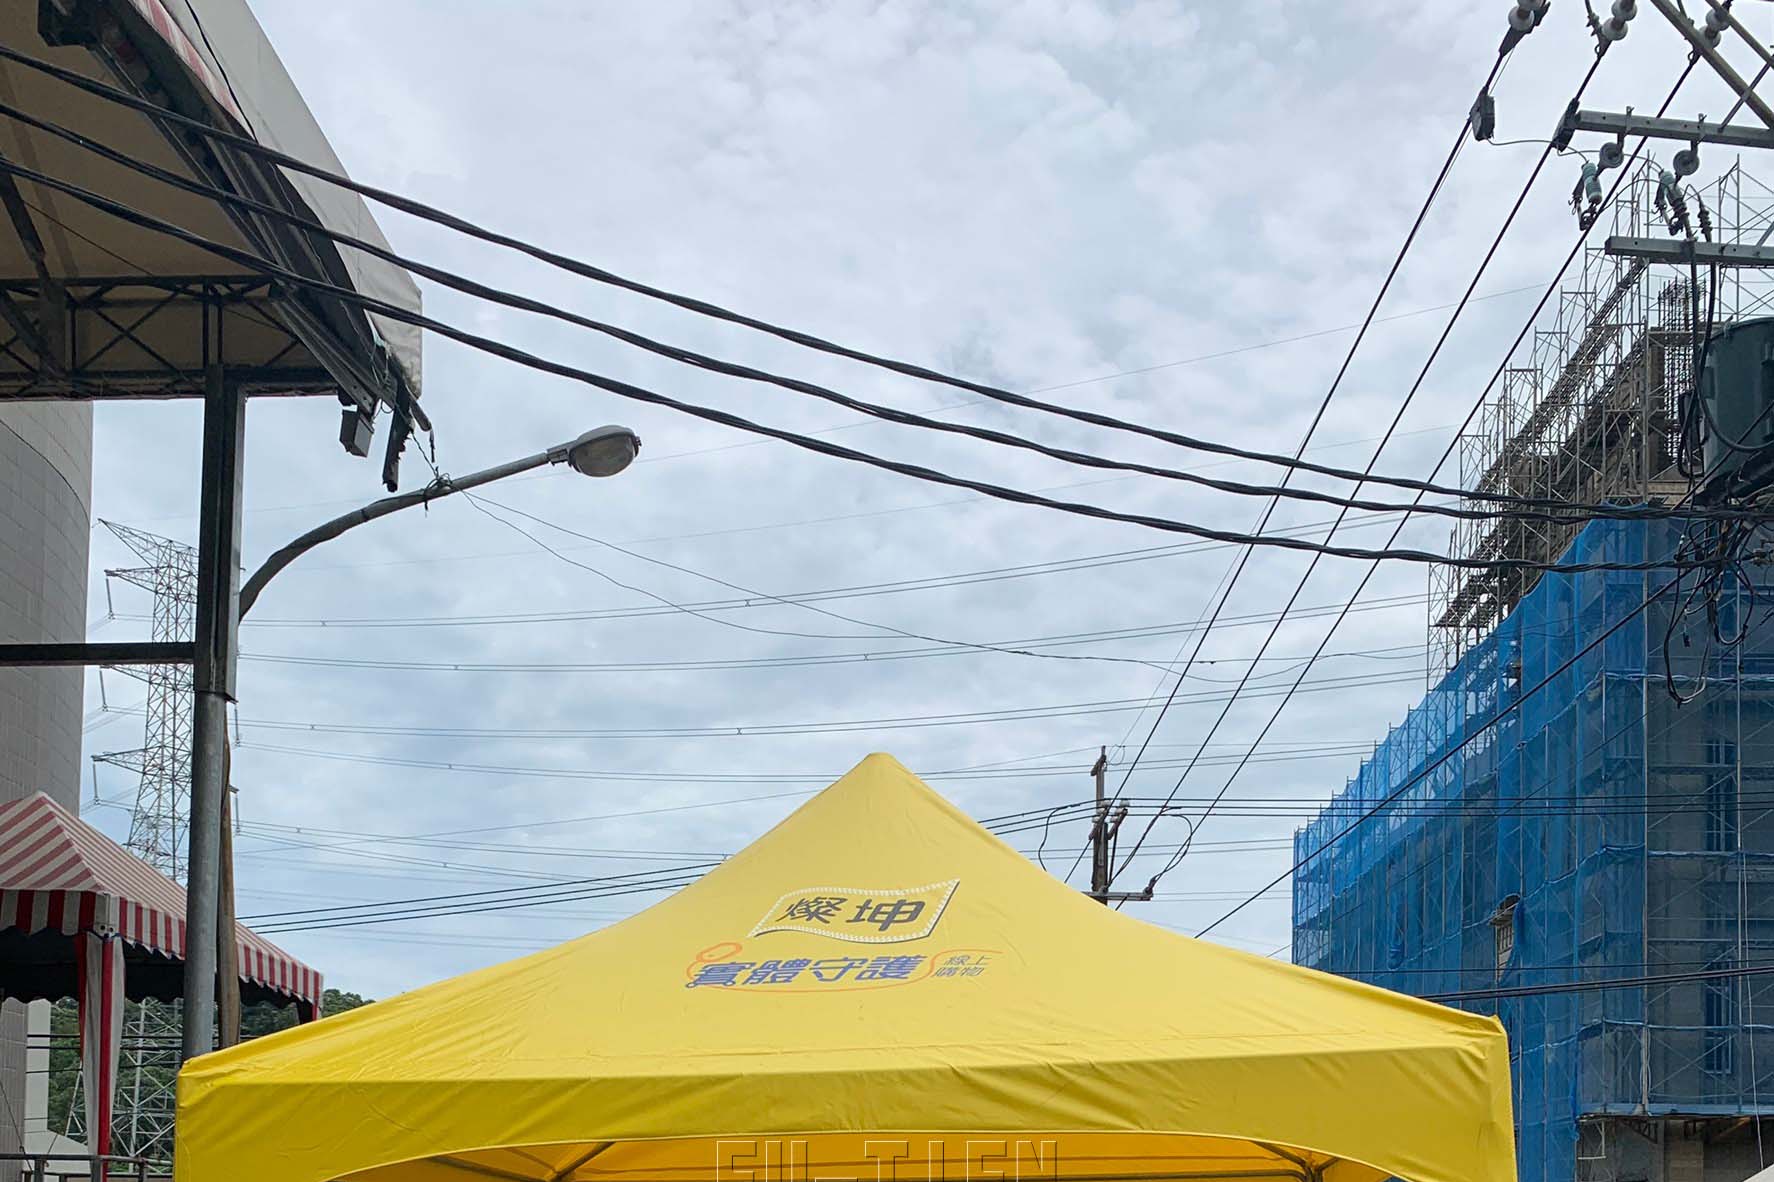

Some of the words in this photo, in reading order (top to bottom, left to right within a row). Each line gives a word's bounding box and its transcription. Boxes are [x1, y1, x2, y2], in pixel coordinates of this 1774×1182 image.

[775, 896, 926, 931] 燦坤
[686, 955, 928, 988] 實體守護
